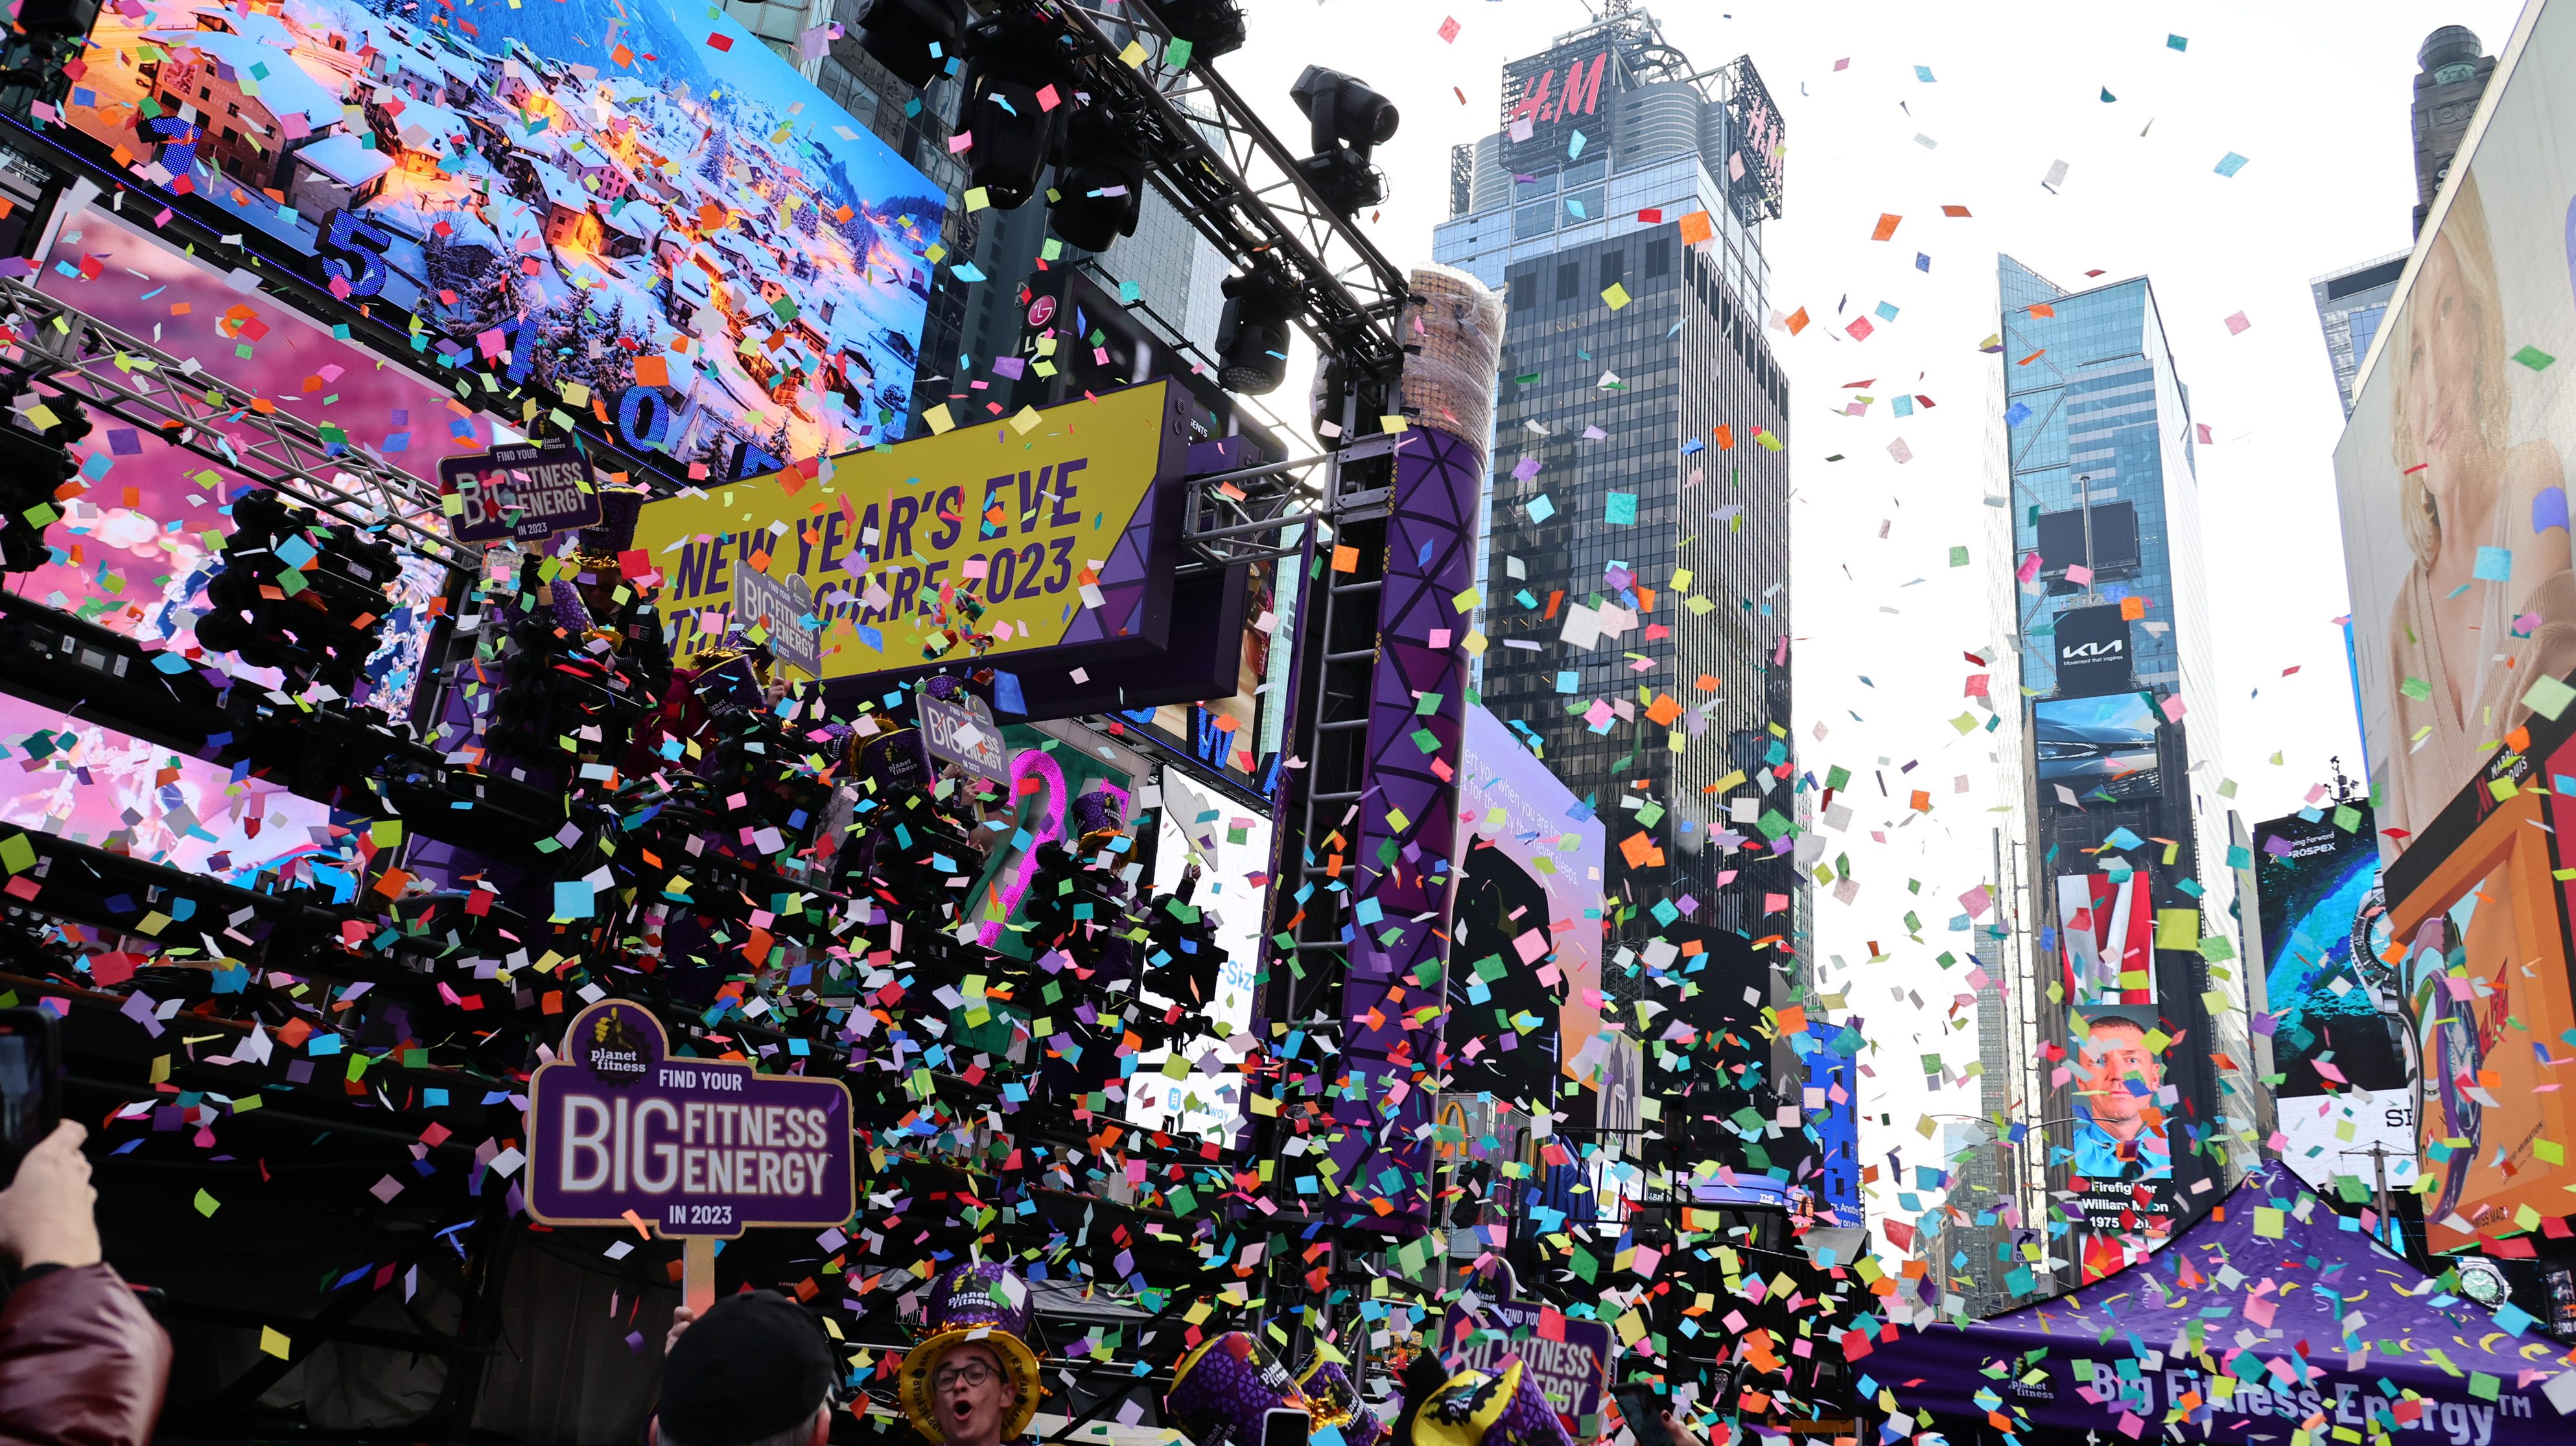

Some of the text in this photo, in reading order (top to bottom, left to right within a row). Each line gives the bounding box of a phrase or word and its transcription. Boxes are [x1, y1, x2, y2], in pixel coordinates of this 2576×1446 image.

[1505, 52, 1608, 138] H&M
[543, 441, 566, 450] fitness
[497, 448, 538, 462] FIND YOUR
[517, 485, 587, 519] ENERGY
[517, 522, 548, 536] IN 2023
[673, 457, 1088, 601] NEW YEAR'S EVE
[768, 580, 791, 603] FIND YOUR
[744, 576, 775, 634] BIG
[776, 618, 814, 662] ENERGY
[778, 644, 790, 659] 2023
[2103, 655, 2124, 663] inspires
[949, 705, 961, 718] FIND
[888, 758, 912, 773] planet
[892, 762, 918, 776] fitness
[963, 759, 981, 774] IN 2023
[1497, 778, 1521, 809] when
[1521, 798, 1536, 826] you
[1536, 813, 1549, 834] are
[1468, 779, 1483, 803] for
[1533, 836, 1555, 863] never
[1554, 854, 1580, 888] sleeps.
[2306, 830, 2335, 845] Forward
[591, 1047, 638, 1062] planet
[596, 1058, 647, 1073] fitness
[659, 1068, 743, 1091] FIND YOUR
[683, 1102, 828, 1149] FITNESS
[560, 1094, 679, 1195] BIG
[2081, 1198, 2170, 1213] William Mon
[668, 1205, 732, 1225] IN 2023
[2089, 1216, 2120, 1228] 1975
[948, 1291, 990, 1307] planet
[953, 1297, 998, 1310] fitness
[1504, 1308, 1540, 1327] FIND YOU
[1260, 1359, 1282, 1386] plane
[2017, 1388, 2054, 1399] fitness
[2091, 1362, 2154, 1416] Bg
[2165, 1368, 2324, 1417] Finess
